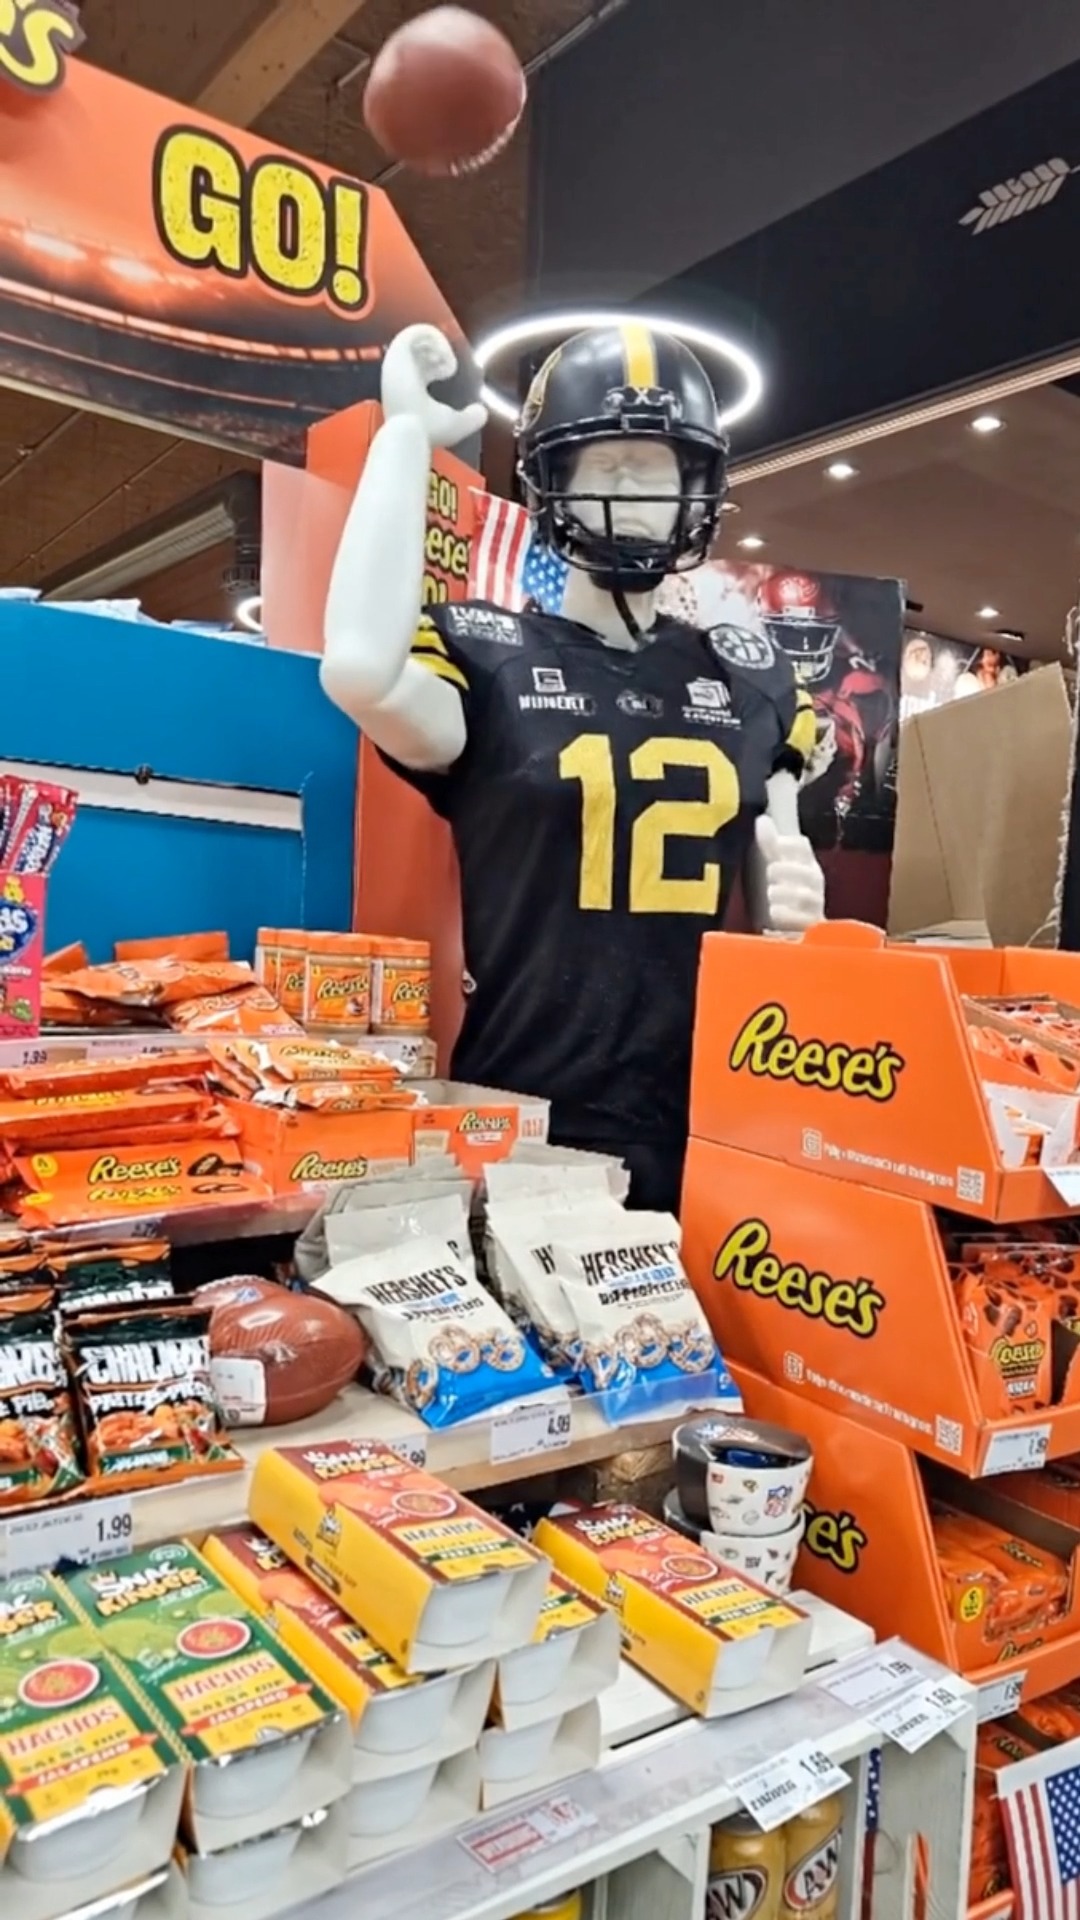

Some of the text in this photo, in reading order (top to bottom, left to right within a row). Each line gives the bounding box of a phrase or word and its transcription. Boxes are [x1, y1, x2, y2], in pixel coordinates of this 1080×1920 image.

[160, 130, 363, 305] GO!
[559, 733, 740, 915] 12
[731, 1004, 903, 1100] Reese's
[89, 1152, 184, 1184] Reese's
[290, 1153, 368, 1181] Reese's
[714, 1220, 884, 1336] Reese's
[97, 1513, 132, 1542] 1.99
